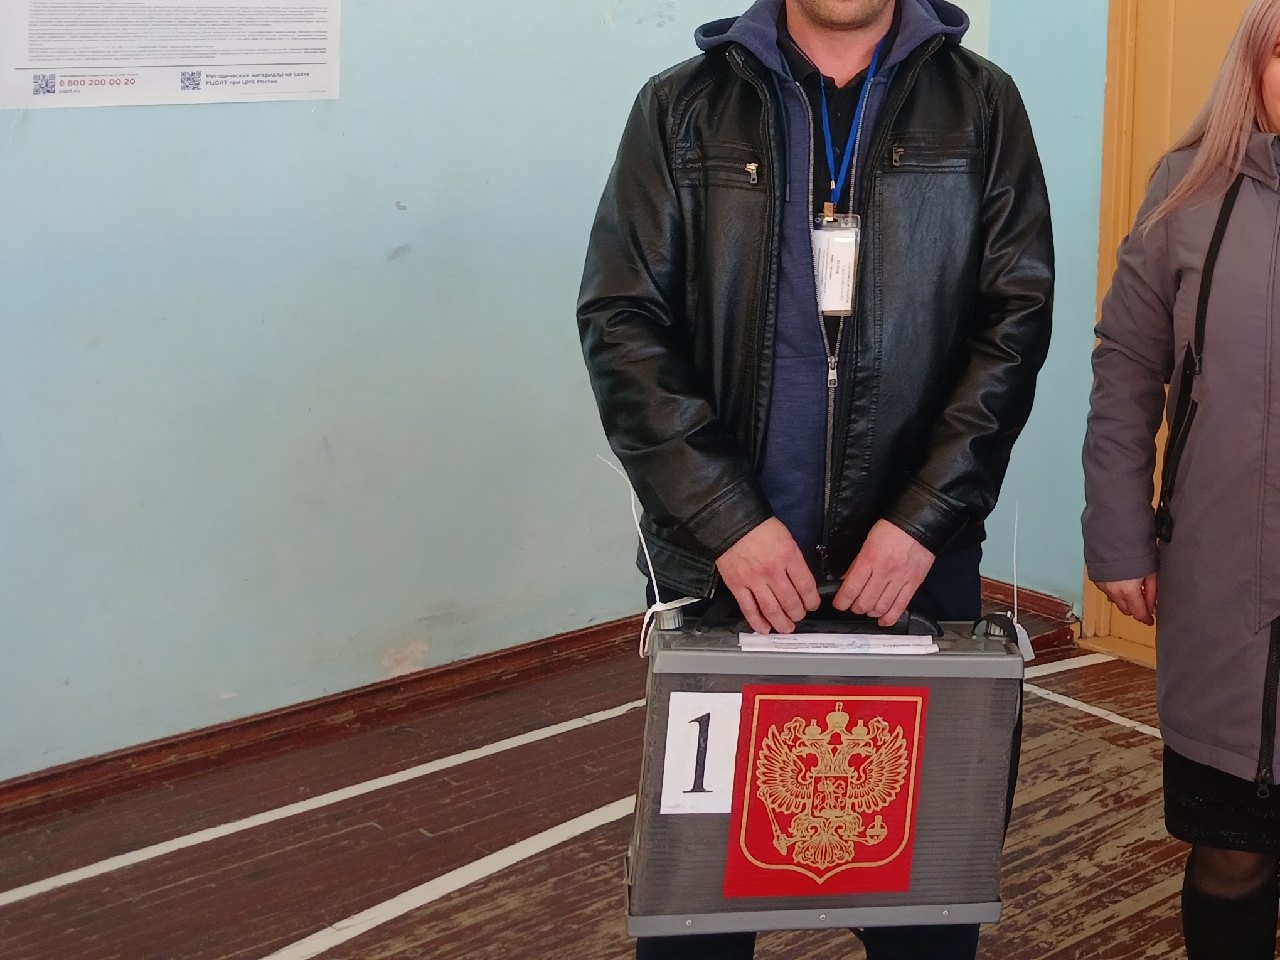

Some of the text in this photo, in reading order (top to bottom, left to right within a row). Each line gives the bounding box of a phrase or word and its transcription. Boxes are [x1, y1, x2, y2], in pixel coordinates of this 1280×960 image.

[67, 79, 86, 87] 800
[88, 78, 106, 86] 200
[124, 78, 136, 86] 20
[682, 711, 714, 794] 1
